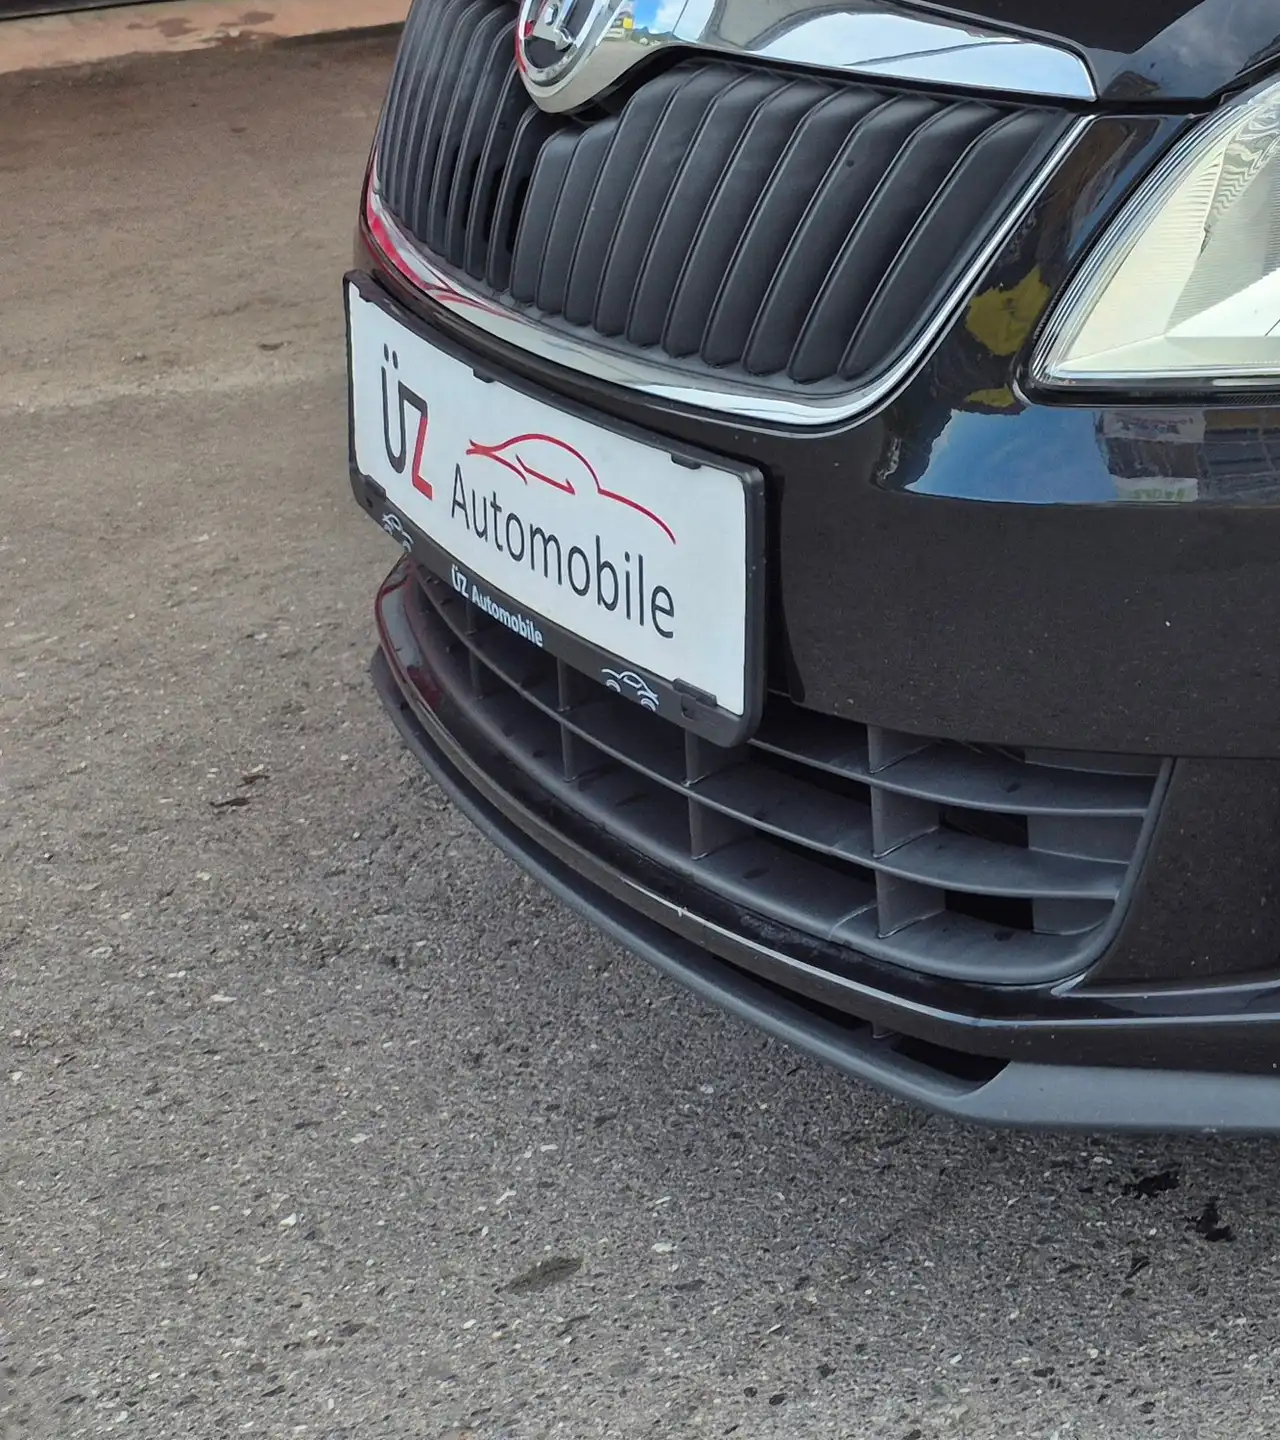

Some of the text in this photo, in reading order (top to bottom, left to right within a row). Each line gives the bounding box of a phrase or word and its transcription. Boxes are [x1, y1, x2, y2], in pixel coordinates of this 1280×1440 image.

[381, 343, 433, 501] ÜZ
[451, 462, 675, 639] Automobile
[451, 563, 543, 647] ÜZ Automobile
